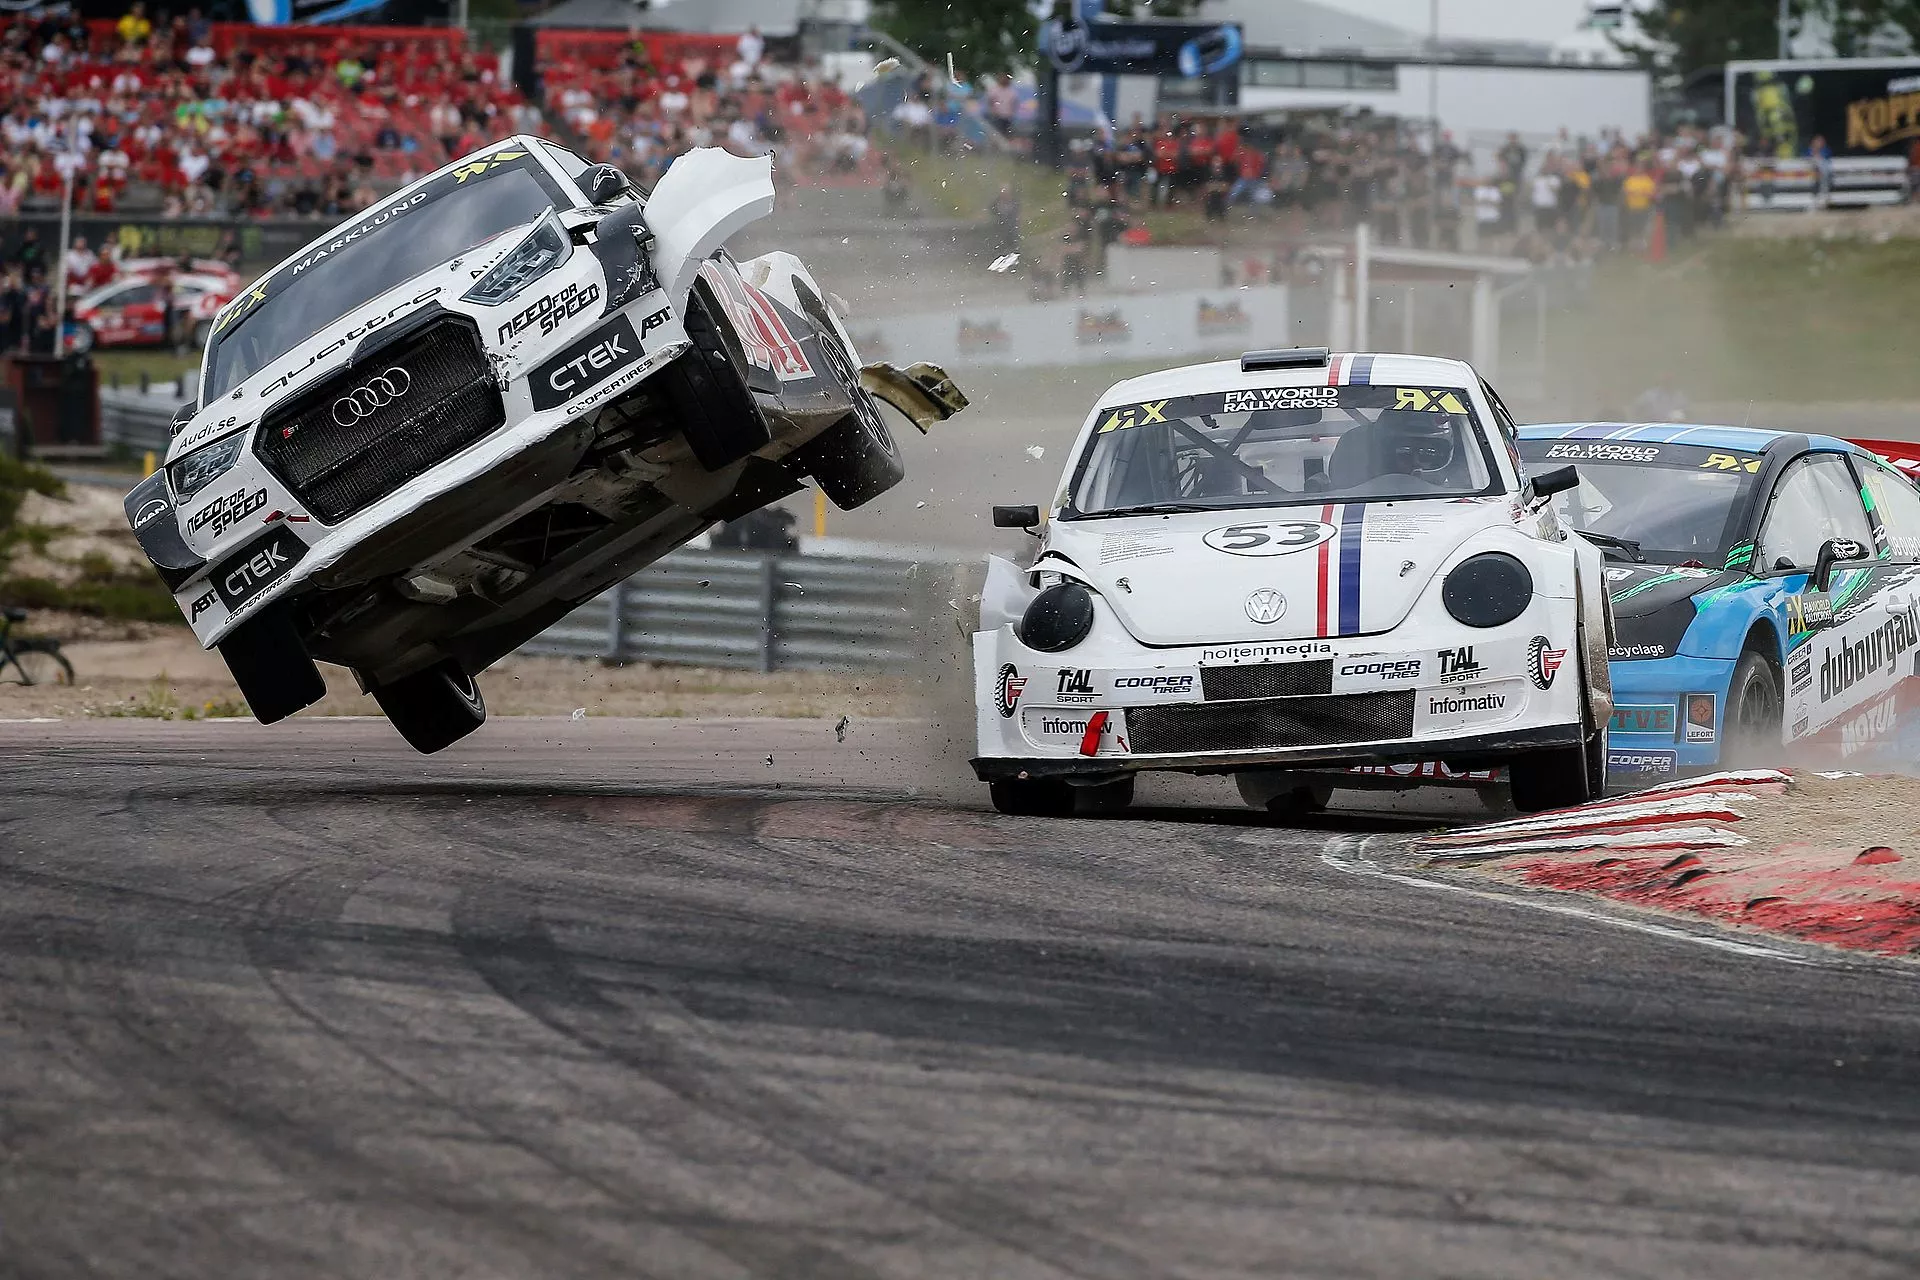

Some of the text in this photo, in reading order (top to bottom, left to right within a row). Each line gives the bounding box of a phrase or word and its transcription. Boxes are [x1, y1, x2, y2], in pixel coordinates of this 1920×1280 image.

[292, 191, 428, 275] MARKLUND
[498, 283, 578, 345] NEED FOR
[540, 283, 600, 337] SPEED
[641, 306, 672, 340] ABT
[260, 287, 442, 398] quattro
[550, 333, 628, 391] CTEK
[1223, 398, 1338, 413] RALLYCROSS
[1225, 387, 1338, 403] FIA WORLD
[178, 415, 236, 453] Audi.se
[1546, 451, 1656, 462] RALLYCROSS
[1551, 444, 1660, 456] FIA WORLD
[137, 503, 167, 527] MAN
[187, 487, 245, 537] NEED FOR
[212, 487, 267, 538] SPEED
[1222, 523, 1321, 549] 53
[225, 541, 288, 596] CTEK
[191, 588, 218, 624] ABT
[1203, 643, 1331, 660] holtenmedia
[1608, 644, 1664, 658] ecyclage
[1340, 660, 1421, 676] COOPER
[1381, 669, 1420, 681] TIRES
[1440, 671, 1480, 684] SPORT
[1114, 675, 1194, 688] COOPER
[1153, 686, 1193, 694] TIRES
[1429, 693, 1505, 715] informativ
[1042, 716, 1113, 734] informv
[1687, 730, 1714, 738] LEFORT
[1841, 695, 1897, 758] MOTUL
[1608, 755, 1671, 765] COOPER
